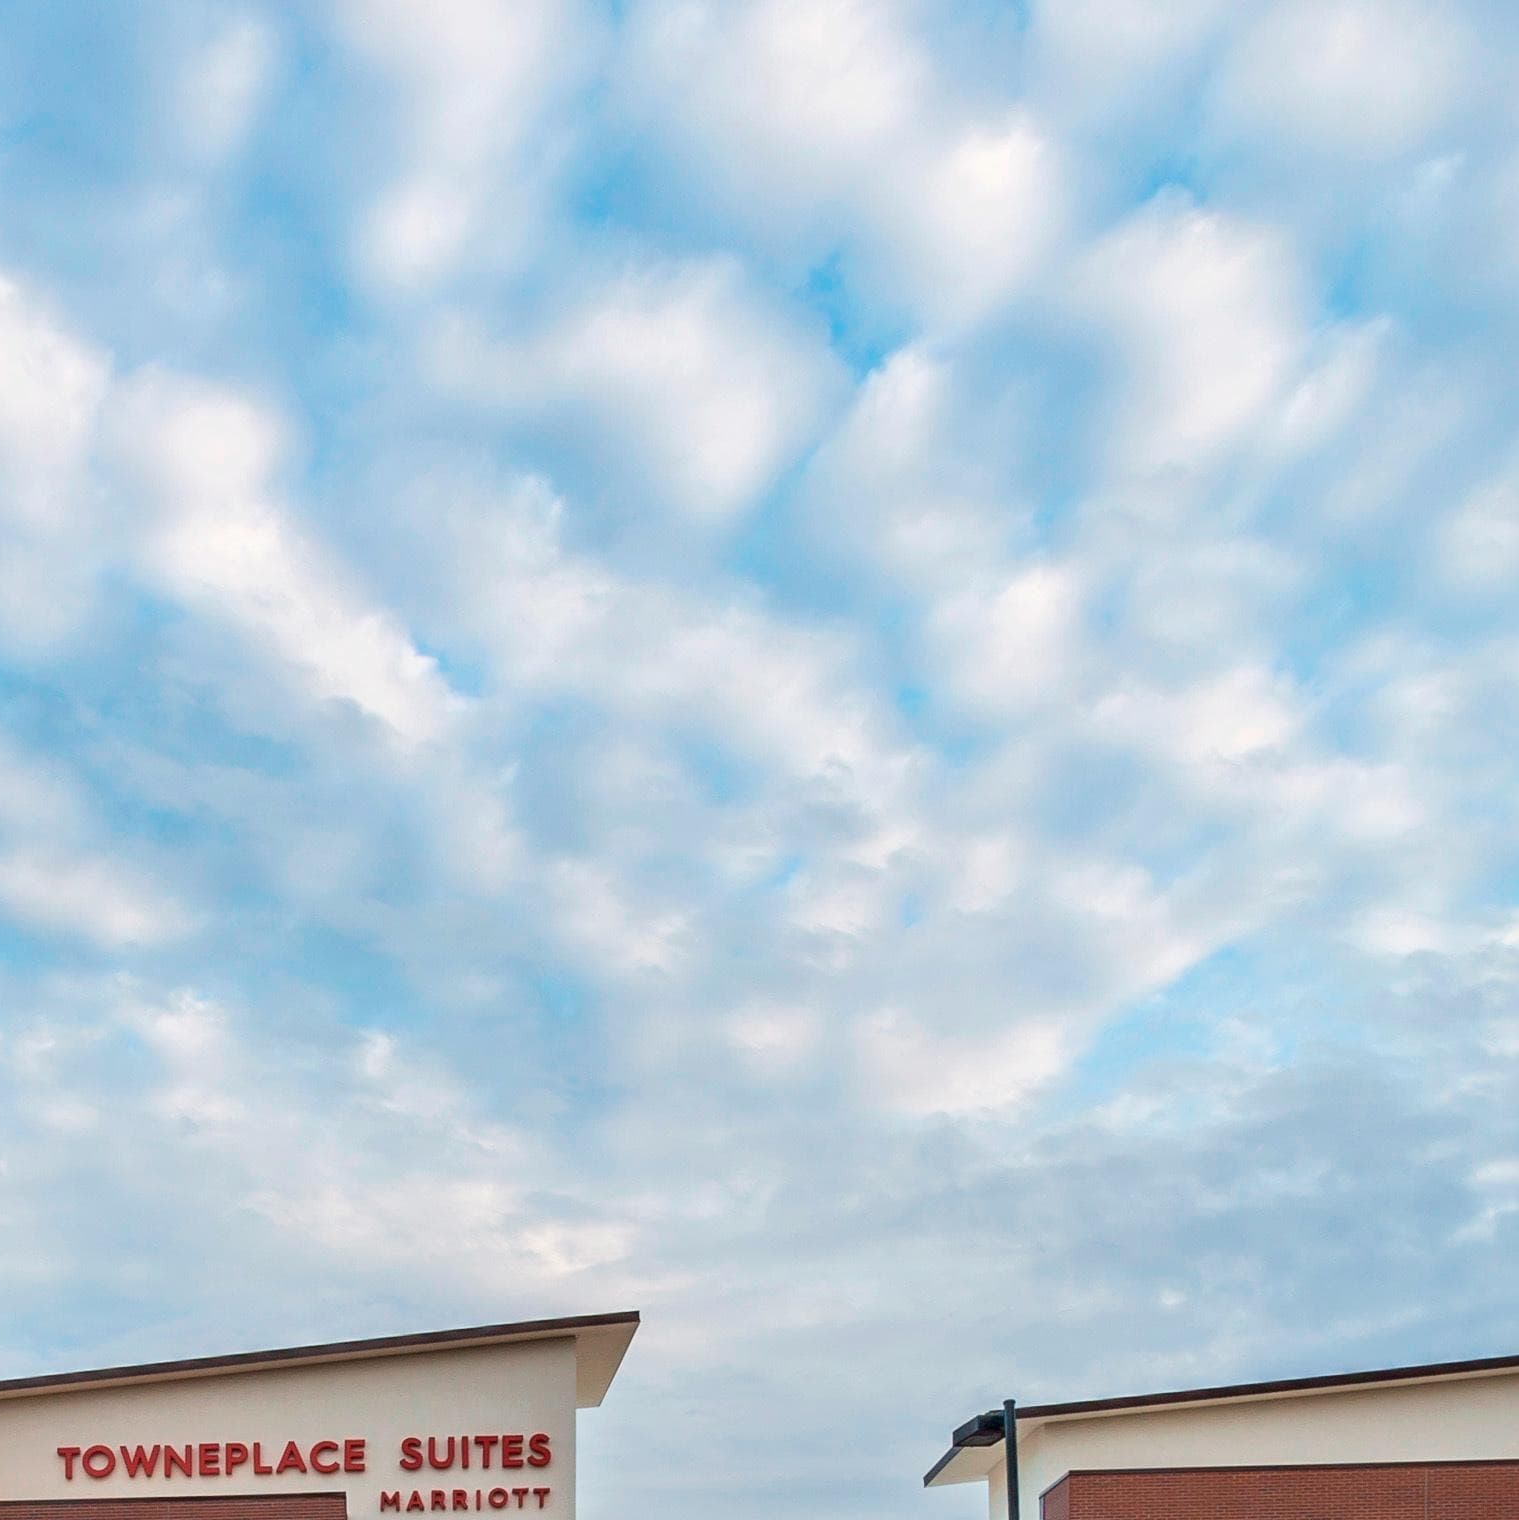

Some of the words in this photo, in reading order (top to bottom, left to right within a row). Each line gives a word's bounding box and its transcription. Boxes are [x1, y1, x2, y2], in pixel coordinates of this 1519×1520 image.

[57, 1438, 367, 1480] TOWNEPLACE
[399, 1433, 552, 1471] SUITES
[379, 1487, 551, 1511] MARRIOTT
